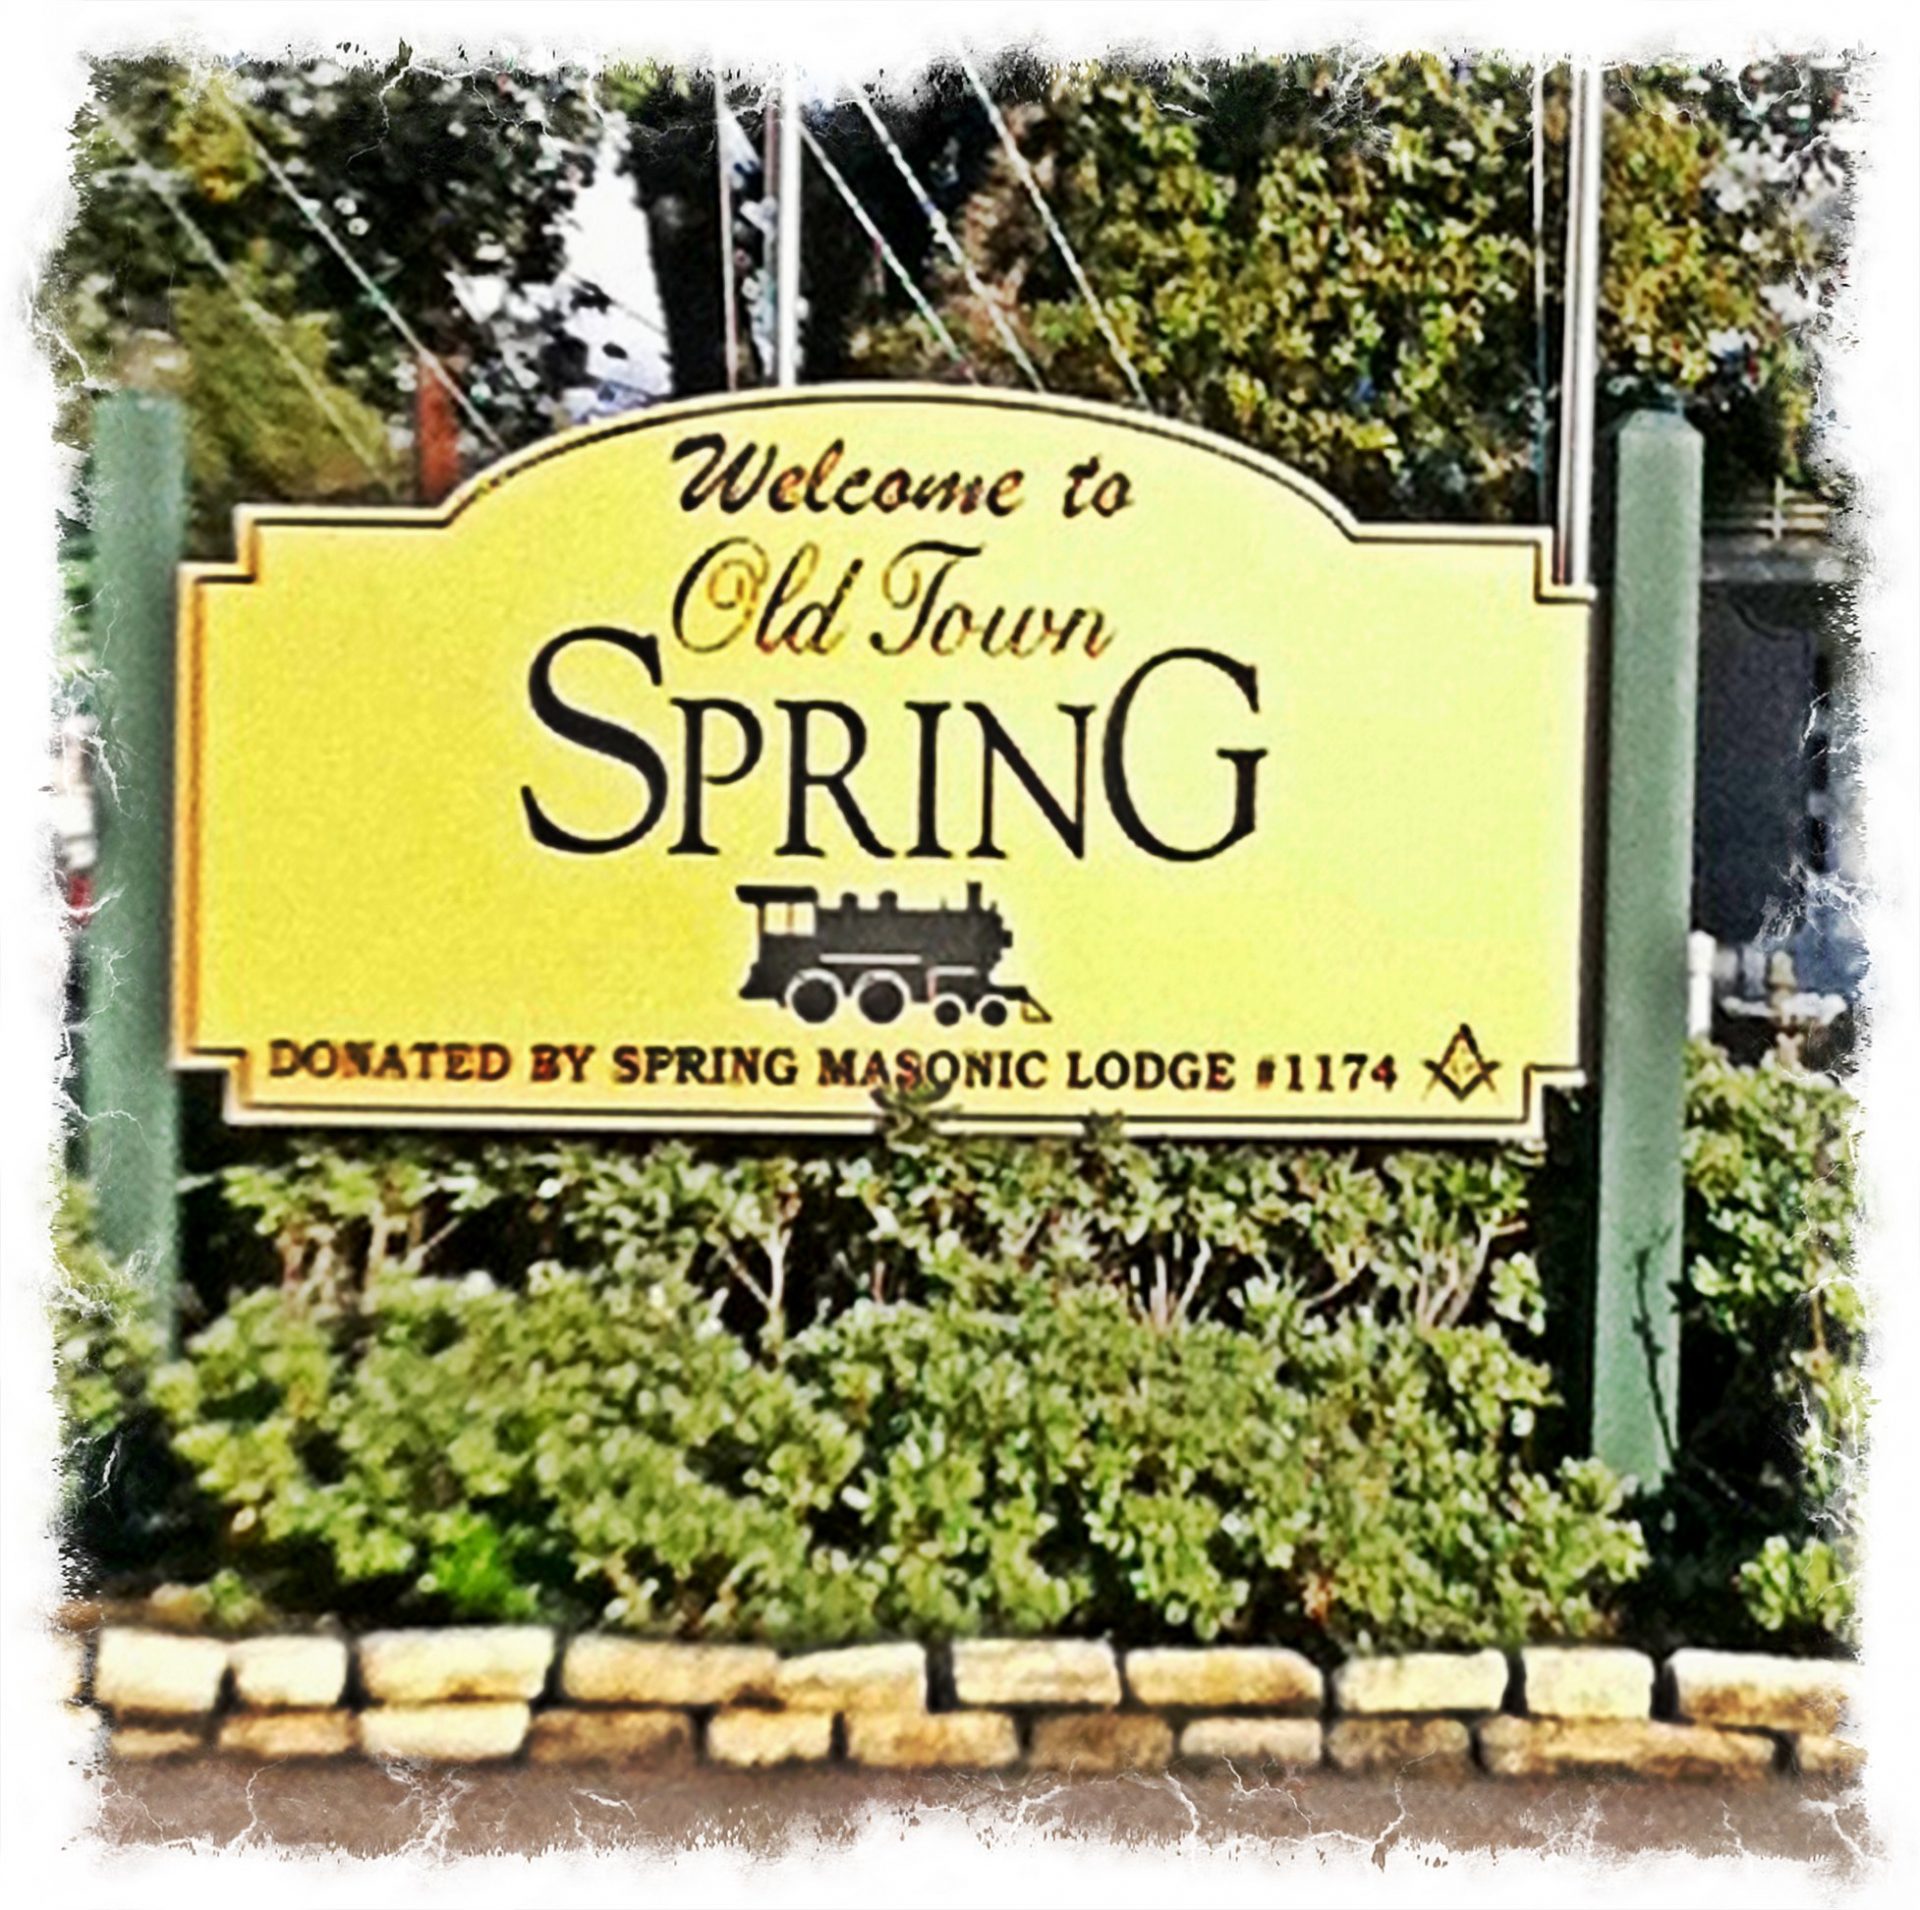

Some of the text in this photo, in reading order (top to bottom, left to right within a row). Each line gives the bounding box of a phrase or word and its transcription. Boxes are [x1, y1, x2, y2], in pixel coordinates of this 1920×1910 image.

[672, 433, 1134, 518] Welcome to
[672, 536, 1115, 658] Old Town
[520, 625, 1267, 862] SPRING
[268, 1039, 1398, 1092] DONATED BY SPRING MASONIC LODGE #1174
